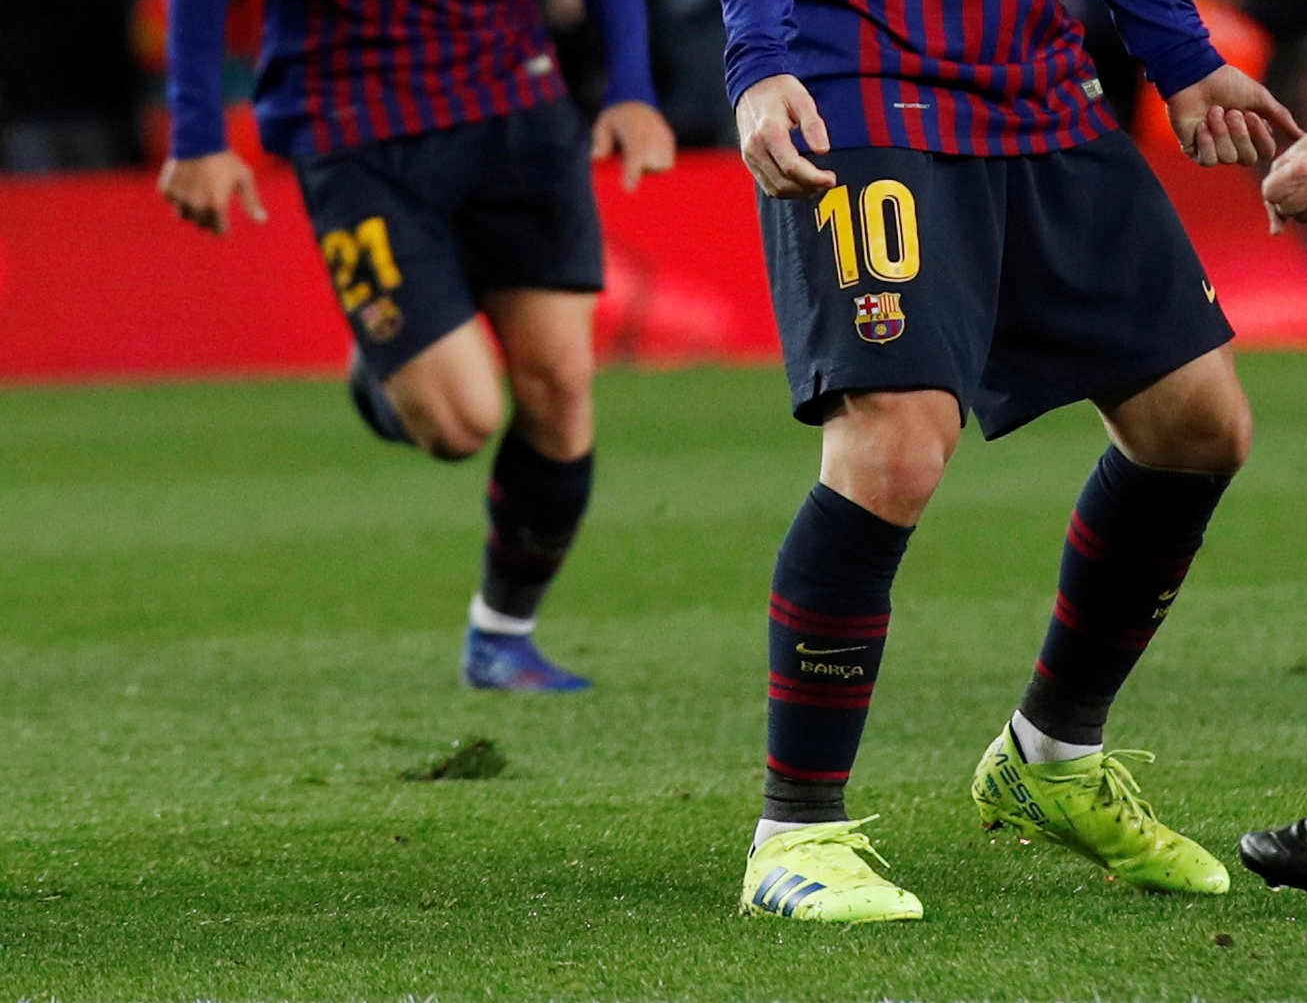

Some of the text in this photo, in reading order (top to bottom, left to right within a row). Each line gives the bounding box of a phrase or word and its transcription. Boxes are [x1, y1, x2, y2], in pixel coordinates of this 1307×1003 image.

[322, 216, 402, 312] 21
[814, 179, 920, 289] 10
[800, 660, 865, 679] BARÇA
